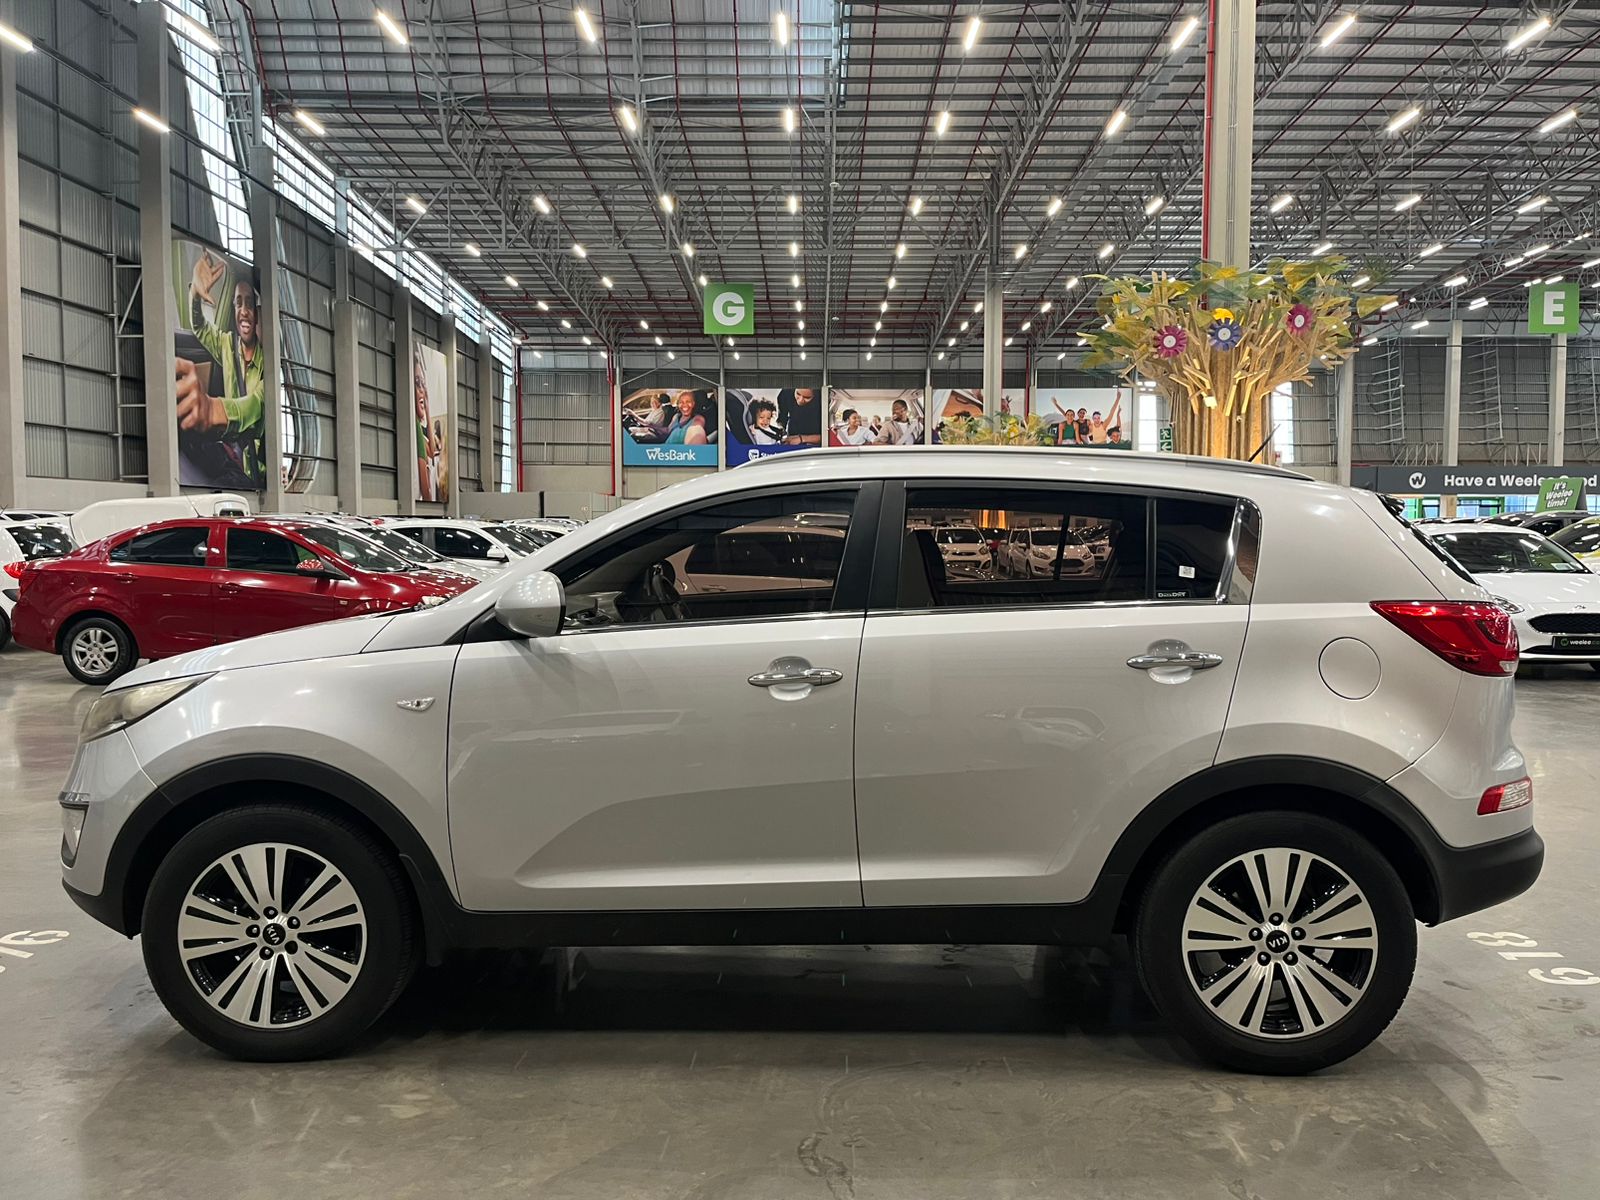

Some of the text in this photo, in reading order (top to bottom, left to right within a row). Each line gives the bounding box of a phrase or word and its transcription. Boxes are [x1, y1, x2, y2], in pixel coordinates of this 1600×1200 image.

[712, 291, 745, 326] G
[1543, 291, 1565, 325] E
[645, 448, 696, 461] WesBank
[1444, 474, 1483, 487] Have
[1486, 476, 1496, 487] a
[1500, 474, 1554, 487] Weele
[266, 925, 280, 944] KIA
